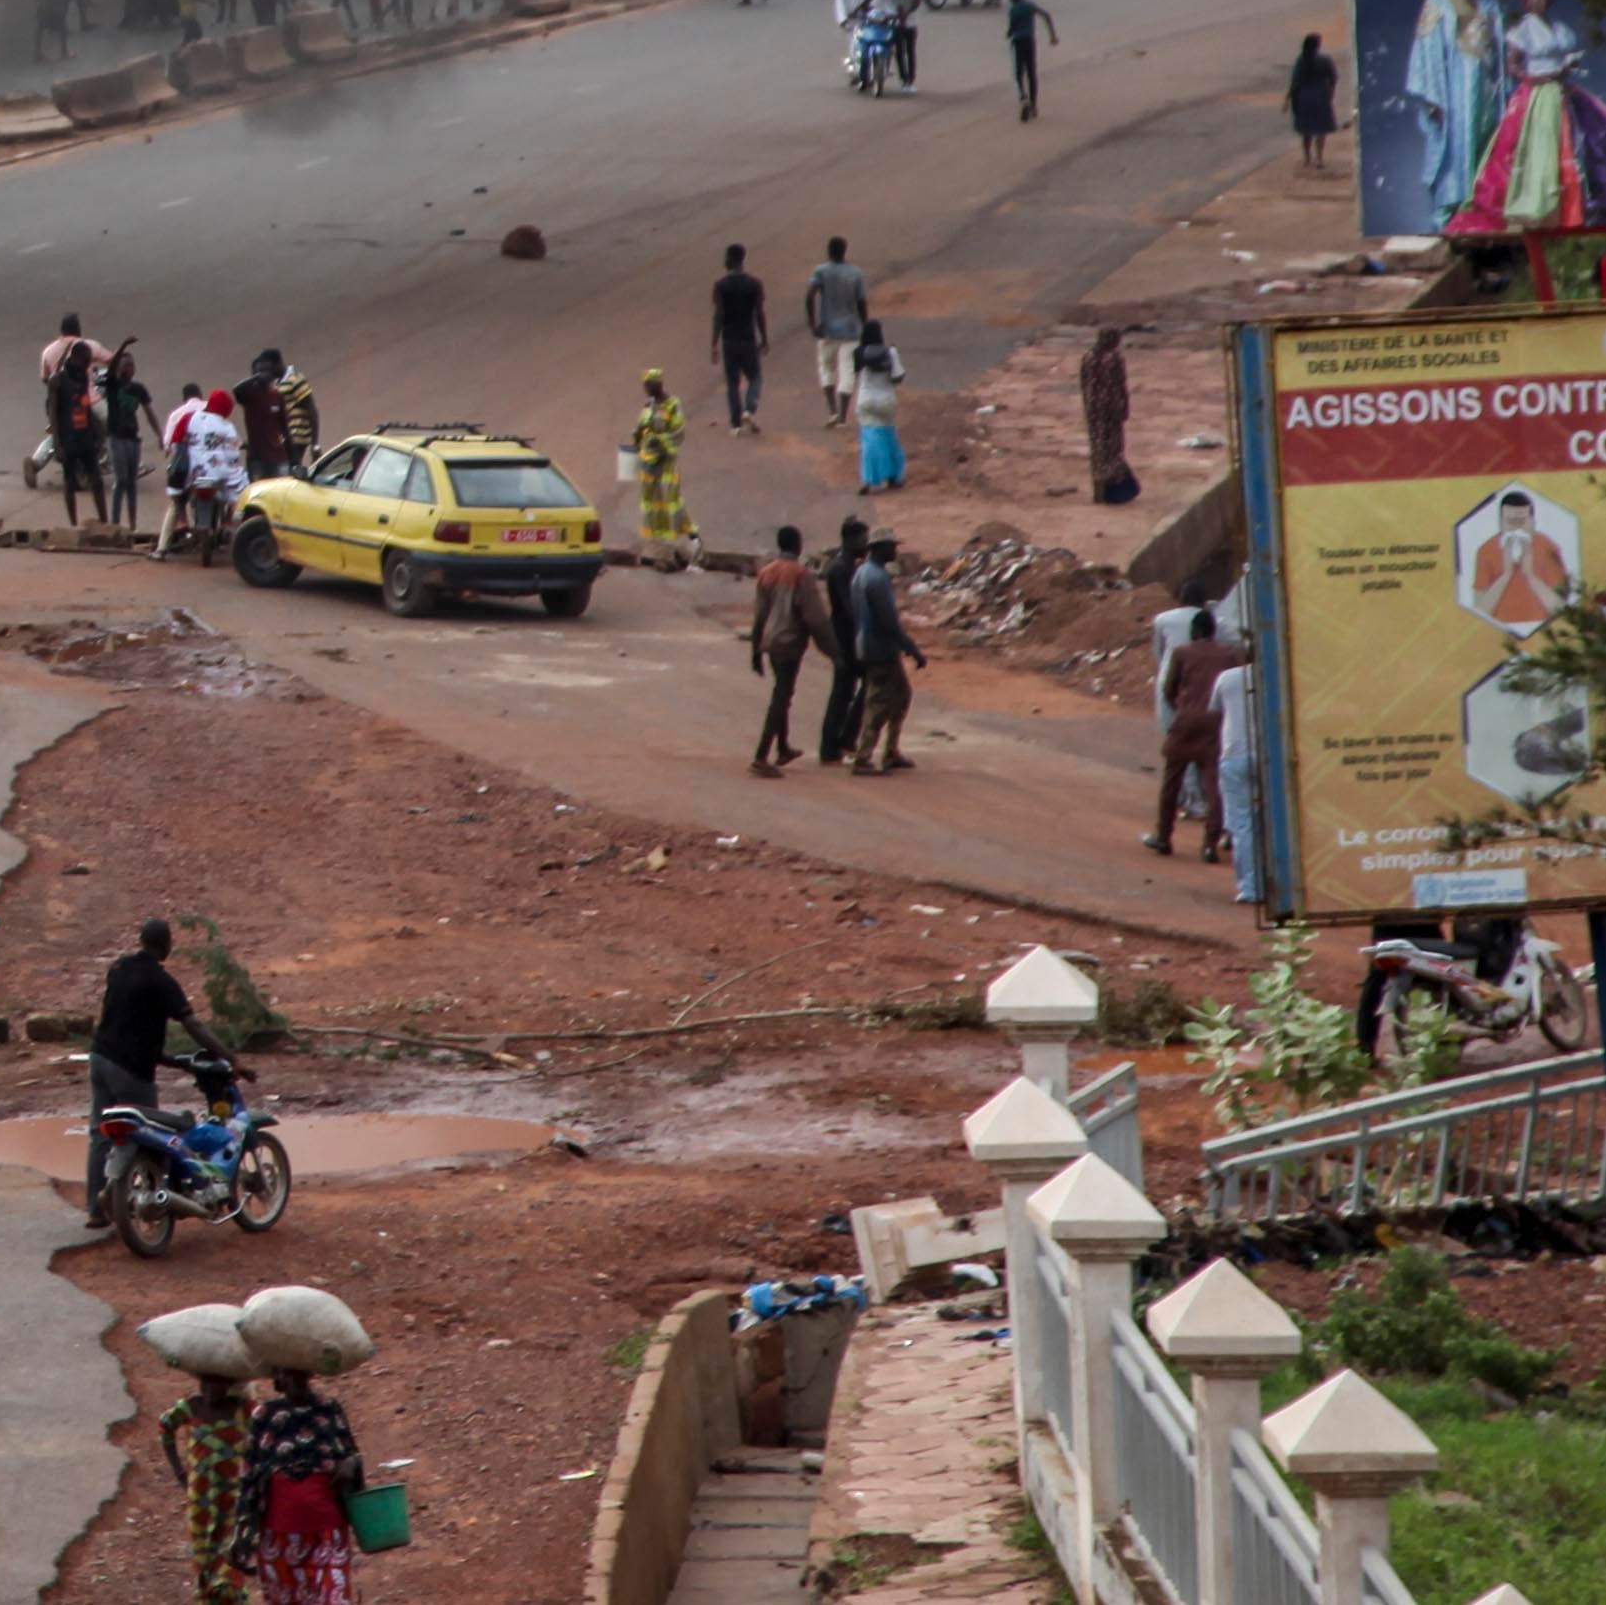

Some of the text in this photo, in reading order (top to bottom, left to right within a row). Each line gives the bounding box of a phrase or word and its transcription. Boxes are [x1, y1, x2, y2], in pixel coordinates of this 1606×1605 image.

[1383, 335, 1405, 349] DE
[1409, 334, 1429, 347] LA
[1489, 330, 1509, 343] ET
[1307, 350, 1501, 374] DES AFFAIRES SOCIALES
[1286, 385, 1483, 429] AGISSONS
[1339, 828, 1368, 847] Le
[1464, 846, 1526, 867] pour
